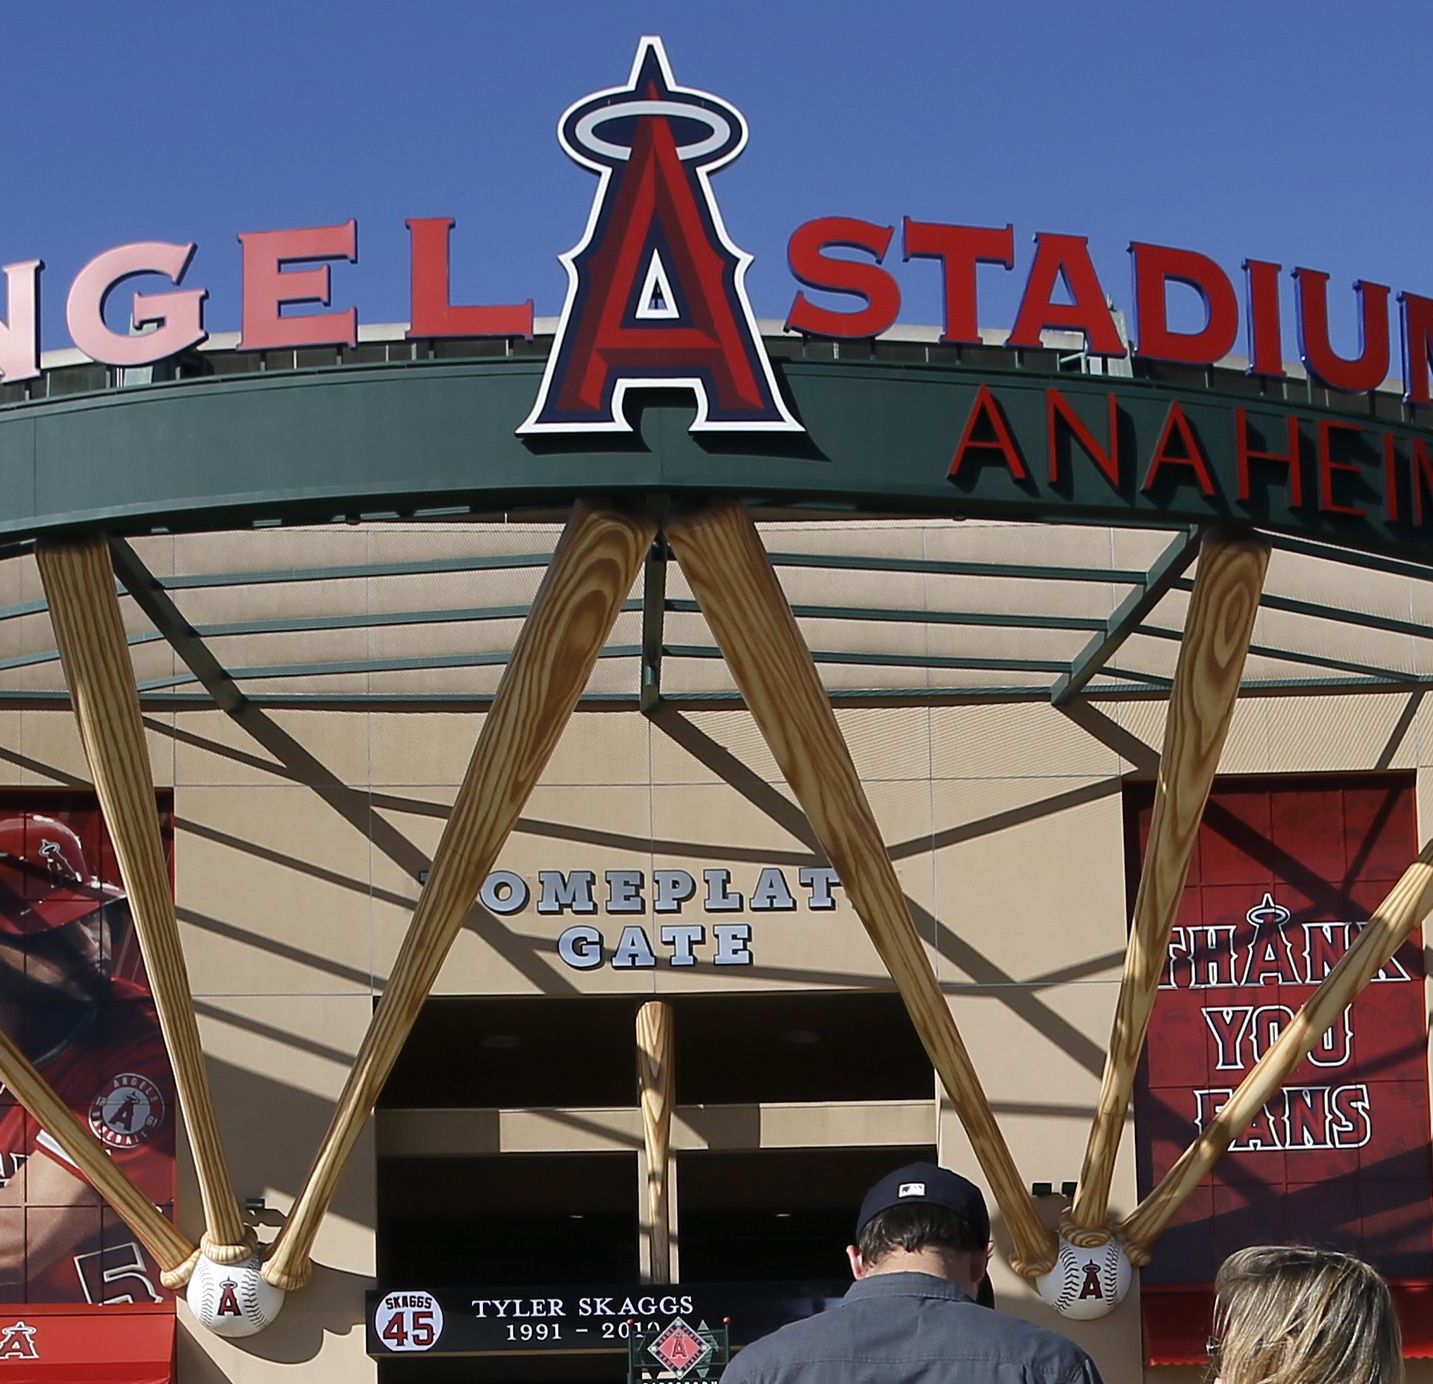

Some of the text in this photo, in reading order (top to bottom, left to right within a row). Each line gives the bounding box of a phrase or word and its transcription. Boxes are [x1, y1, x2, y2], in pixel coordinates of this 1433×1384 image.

[479, 867, 843, 914] OMEPLAT
[557, 923, 753, 968] GATE
[1201, 1003, 1353, 1070] YOU
[1193, 1084, 1372, 1152] FANS
[385, 1296, 433, 1310] SKAGGS
[472, 1296, 694, 1318] TYLER SKAGGS
[382, 1311, 435, 1347] 45
[507, 1323, 562, 1342] 1991
